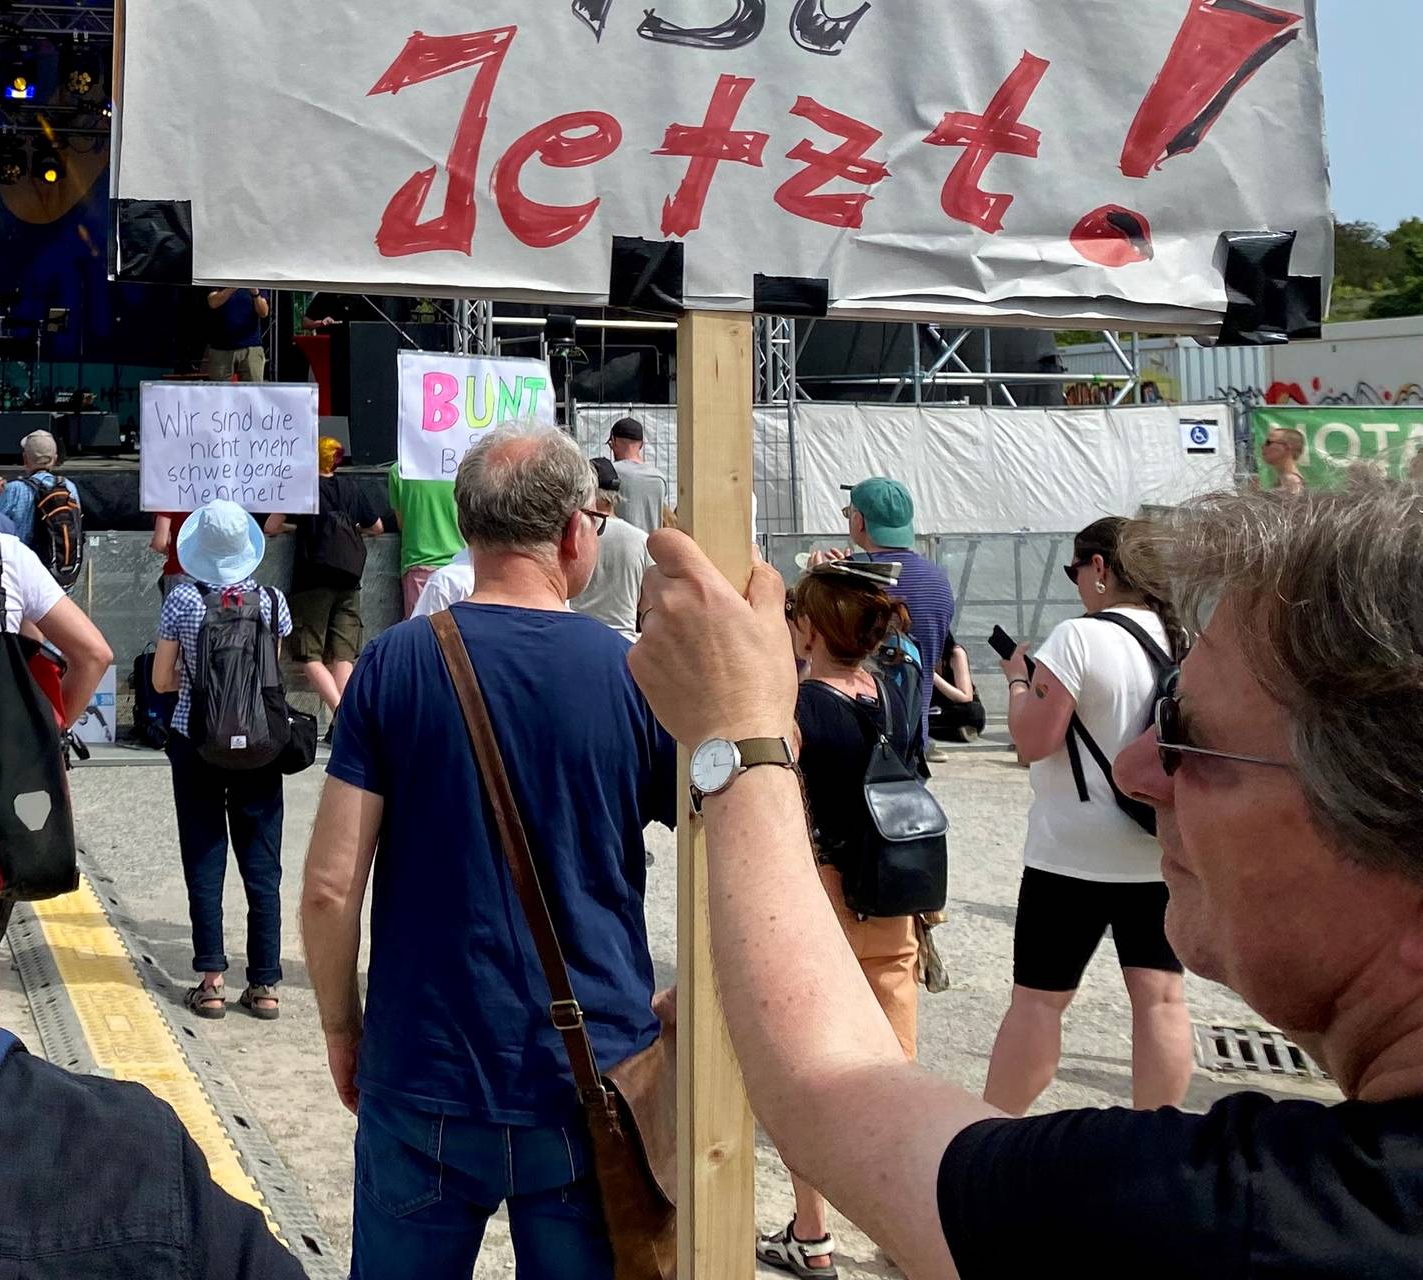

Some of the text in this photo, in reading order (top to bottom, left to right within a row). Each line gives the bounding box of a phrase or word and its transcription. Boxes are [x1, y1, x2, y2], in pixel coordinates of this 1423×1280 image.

[422, 371, 547, 432] BUNT
[155, 400, 293, 439] Wir sind die
[191, 436, 299, 459] nicht mehr
[1269, 422, 1423, 480] OT
[168, 459, 293, 484] schweigende
[178, 482, 285, 505] Mehrheit
